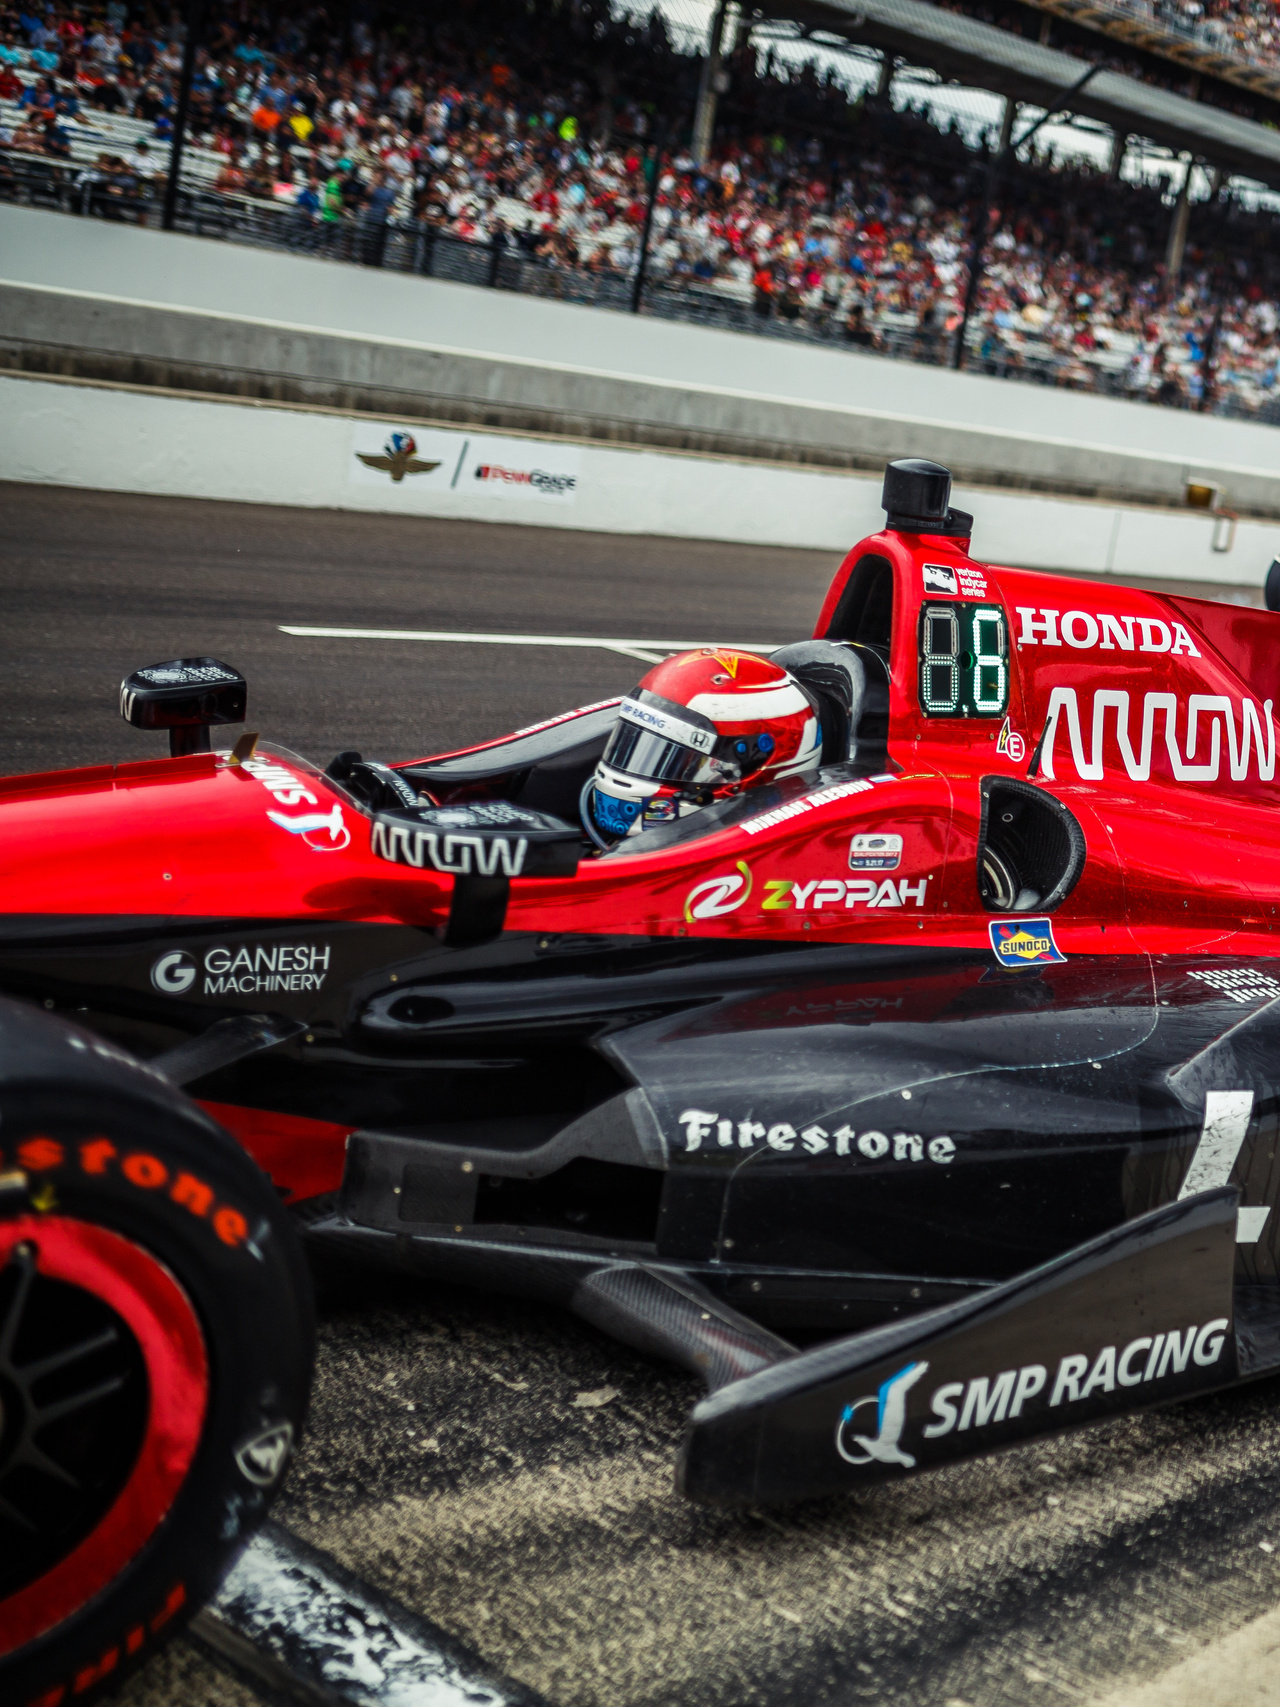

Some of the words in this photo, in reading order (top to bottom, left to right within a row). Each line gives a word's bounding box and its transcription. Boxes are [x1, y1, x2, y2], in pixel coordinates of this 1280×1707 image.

[955, 568, 984, 579] verizon
[958, 576, 988, 589] indycar
[961, 587, 986, 598] series
[1015, 606, 1202, 658] HONDA
[632, 708, 667, 729] RACING
[1041, 687, 1276, 782] ARROW
[371, 821, 528, 877] ARROW
[762, 879, 928, 911] ZYPPAH
[204, 946, 331, 974] GANESH
[1003, 940, 1048, 953] SUNOCO
[204, 973, 326, 995] MACHINERY
[679, 1109, 957, 1164] Firestone
[924, 1364, 1046, 1439] SMP
[1049, 1318, 1229, 1408] RACING
